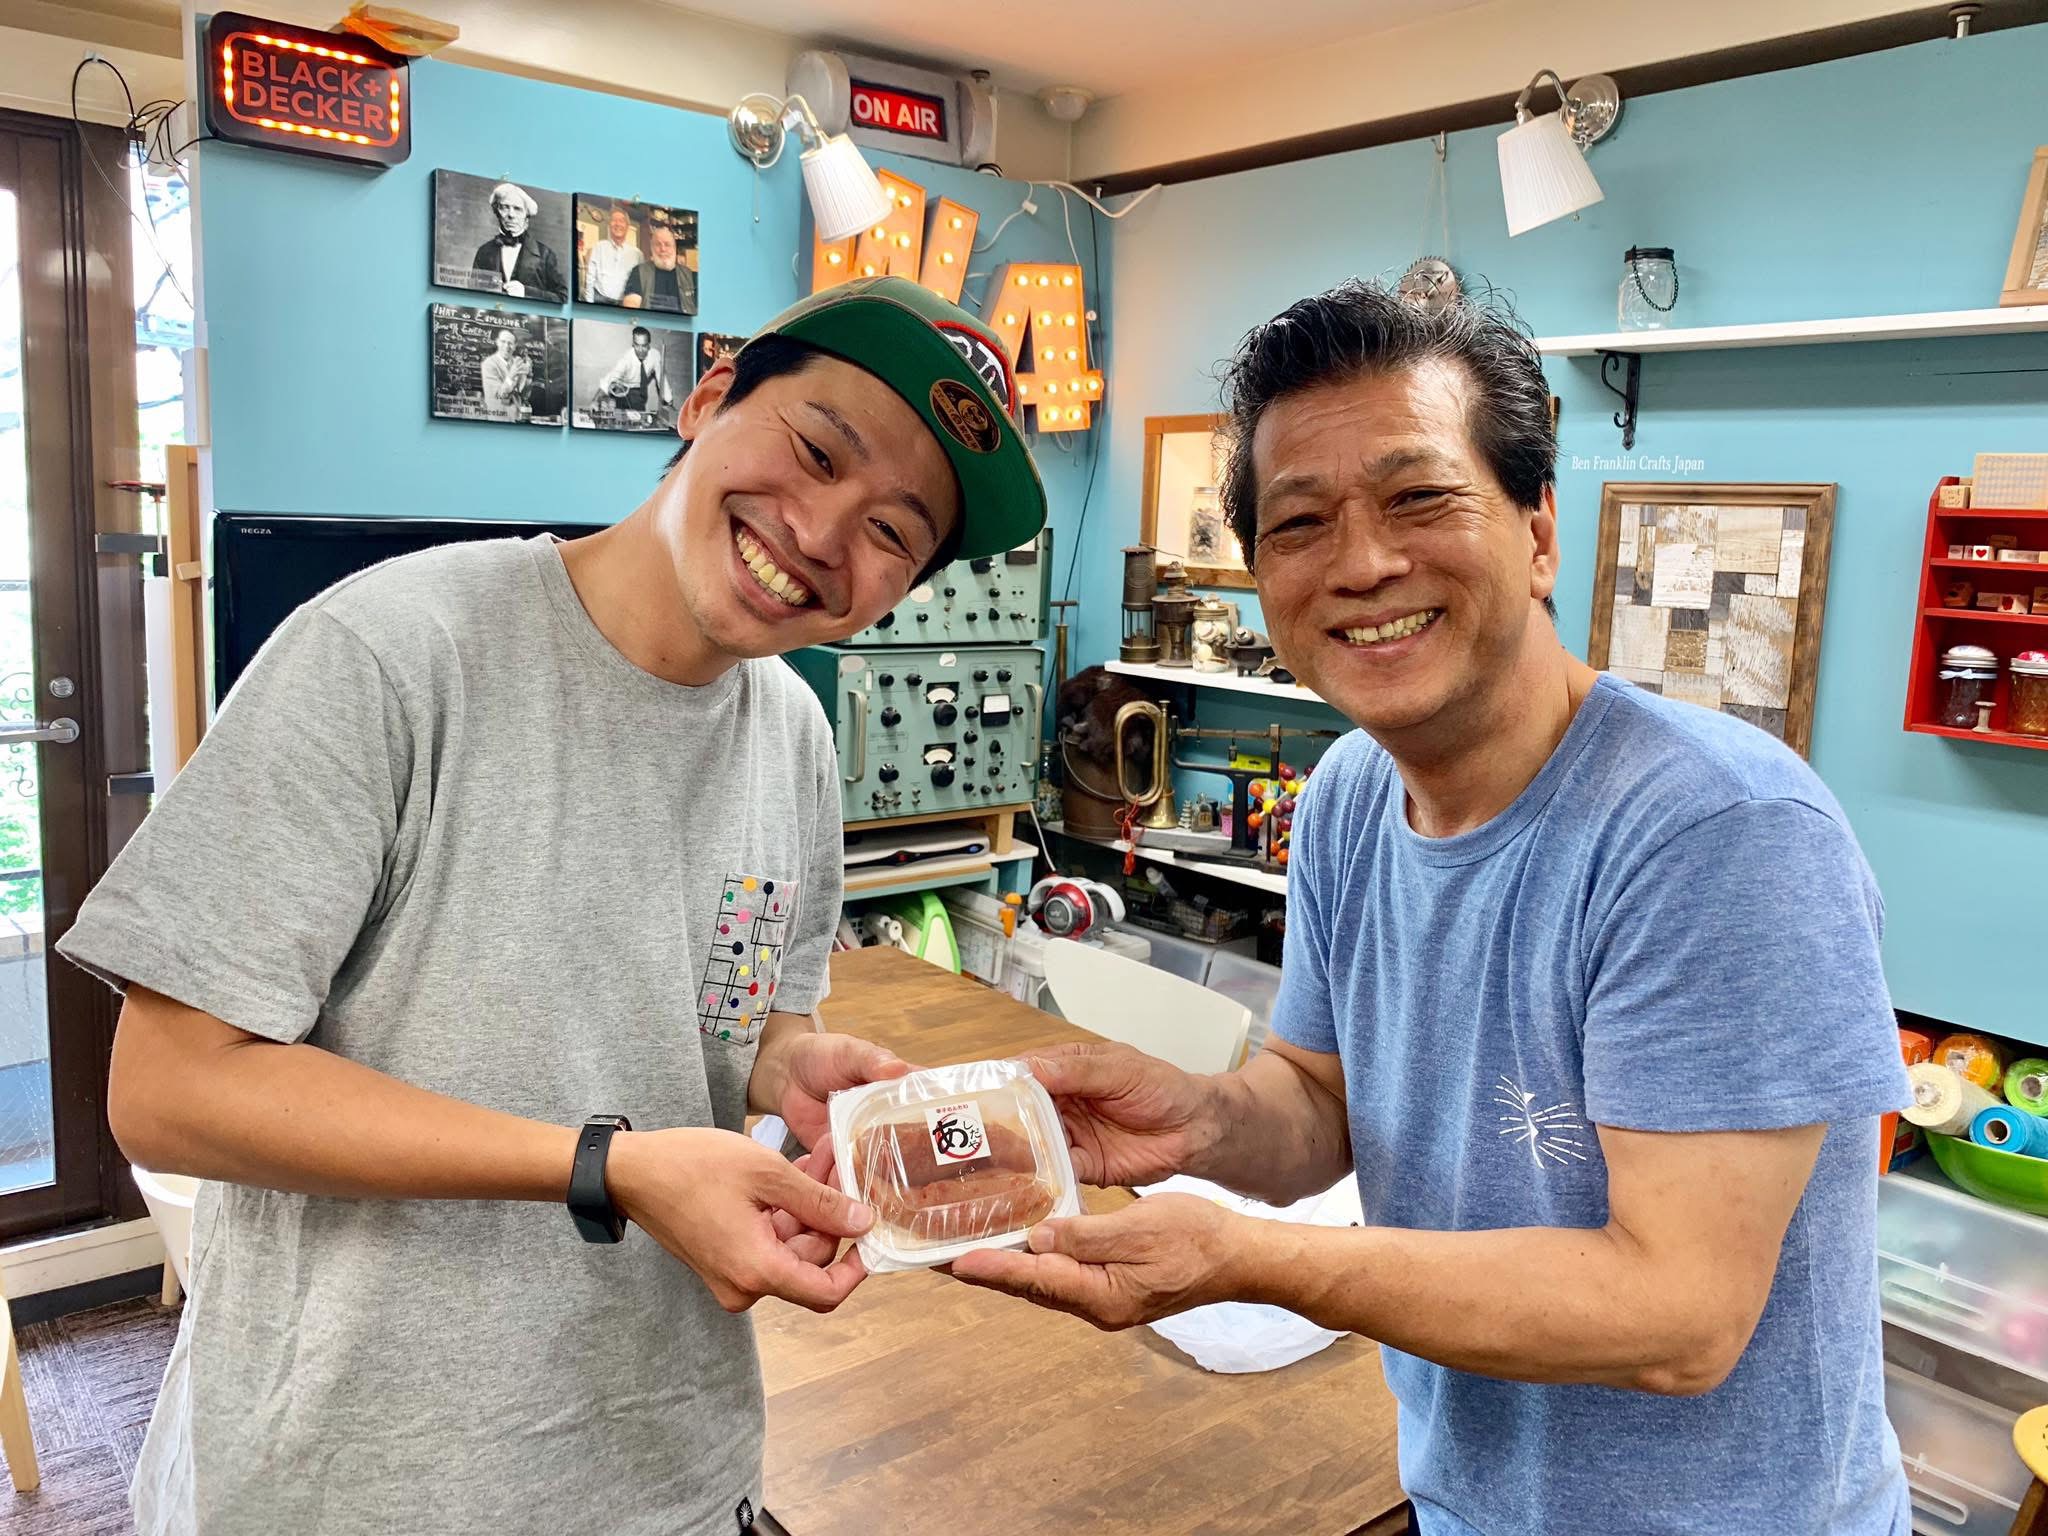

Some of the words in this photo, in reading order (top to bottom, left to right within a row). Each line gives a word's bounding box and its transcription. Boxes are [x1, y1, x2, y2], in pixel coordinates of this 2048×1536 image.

[242, 49, 382, 99] BLACK+
[242, 82, 384, 131] DECKER
[853, 93, 891, 124] ON
[896, 107, 937, 133] AIR
[1571, 455, 1591, 471] Ben
[1593, 455, 1636, 471] Franklin
[1639, 455, 1672, 471] Crafts
[1672, 456, 1705, 475] Japan
[241, 527, 272, 535] REGZA
